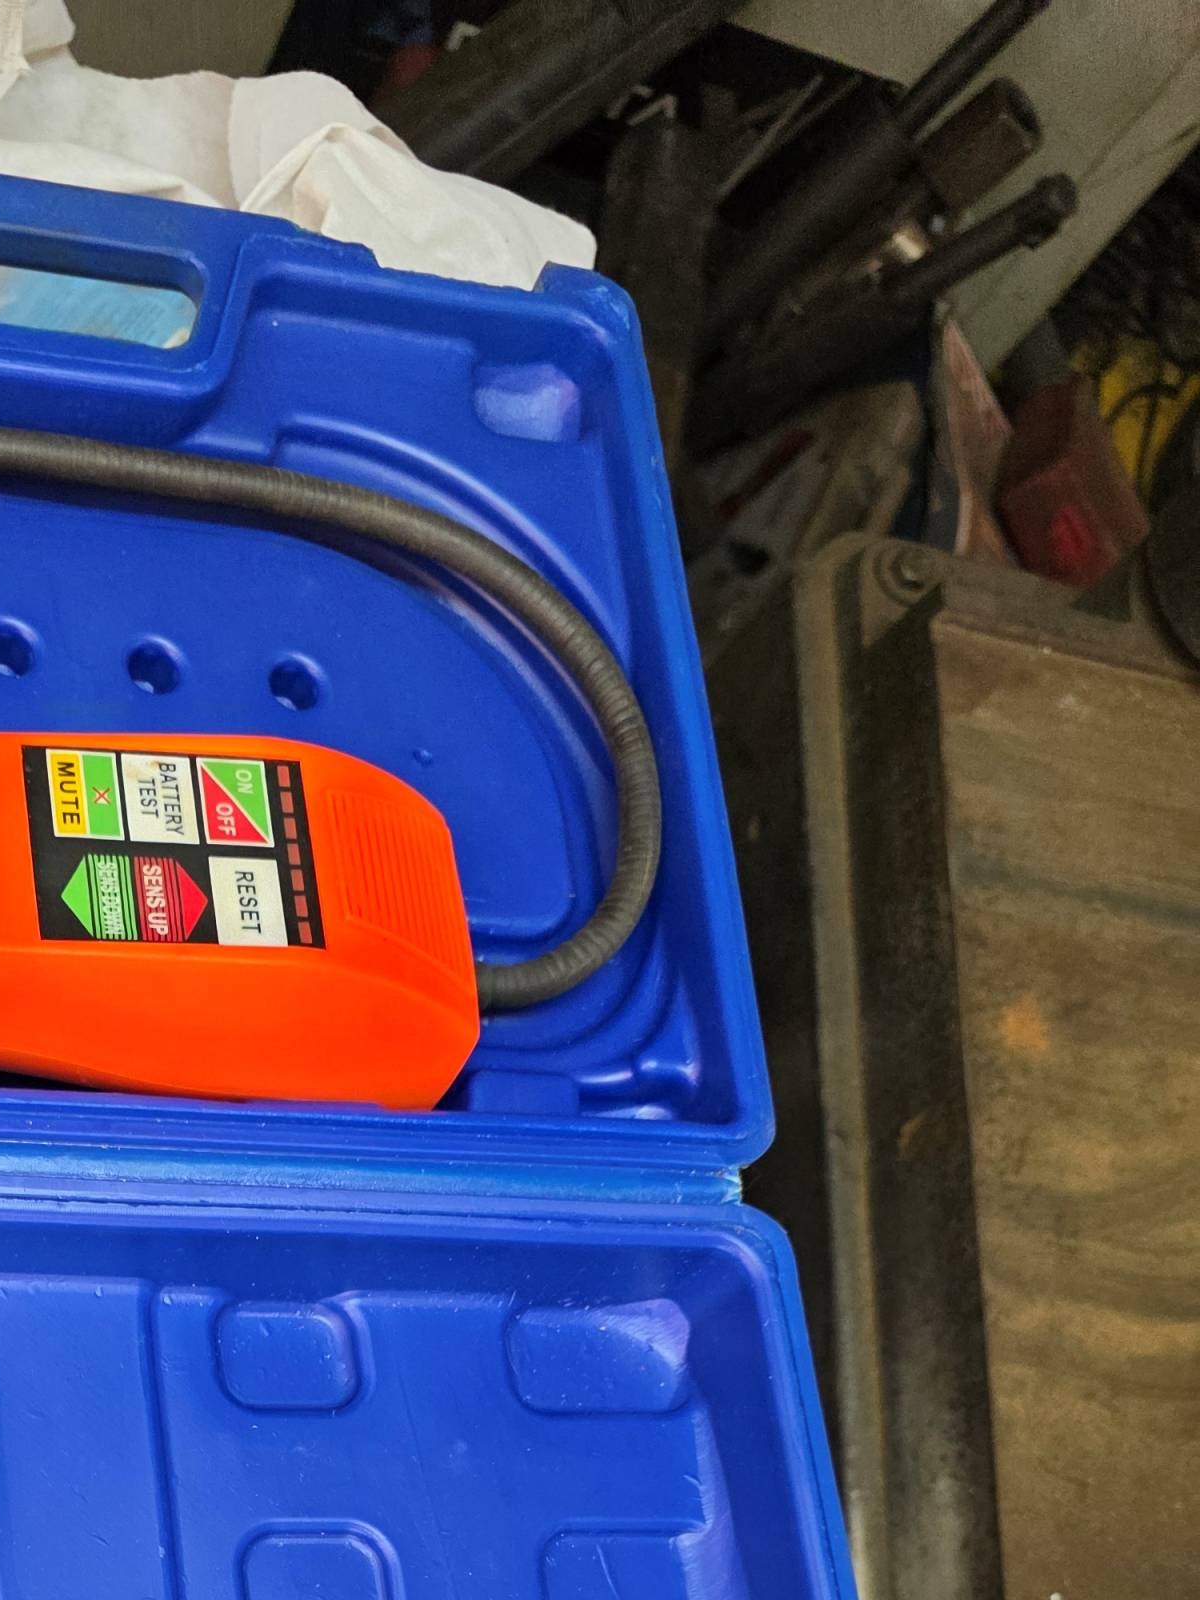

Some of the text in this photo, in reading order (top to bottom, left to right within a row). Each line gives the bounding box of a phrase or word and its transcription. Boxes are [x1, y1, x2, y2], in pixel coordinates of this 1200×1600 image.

[56, 761, 81, 825] MUTE
[138, 778, 159, 819] TEST
[158, 762, 184, 836] BATTERY
[235, 768, 254, 795] ON
[215, 802, 236, 837] OFF
[142, 864, 169, 936] SENS UP
[234, 870, 262, 935] RESET
